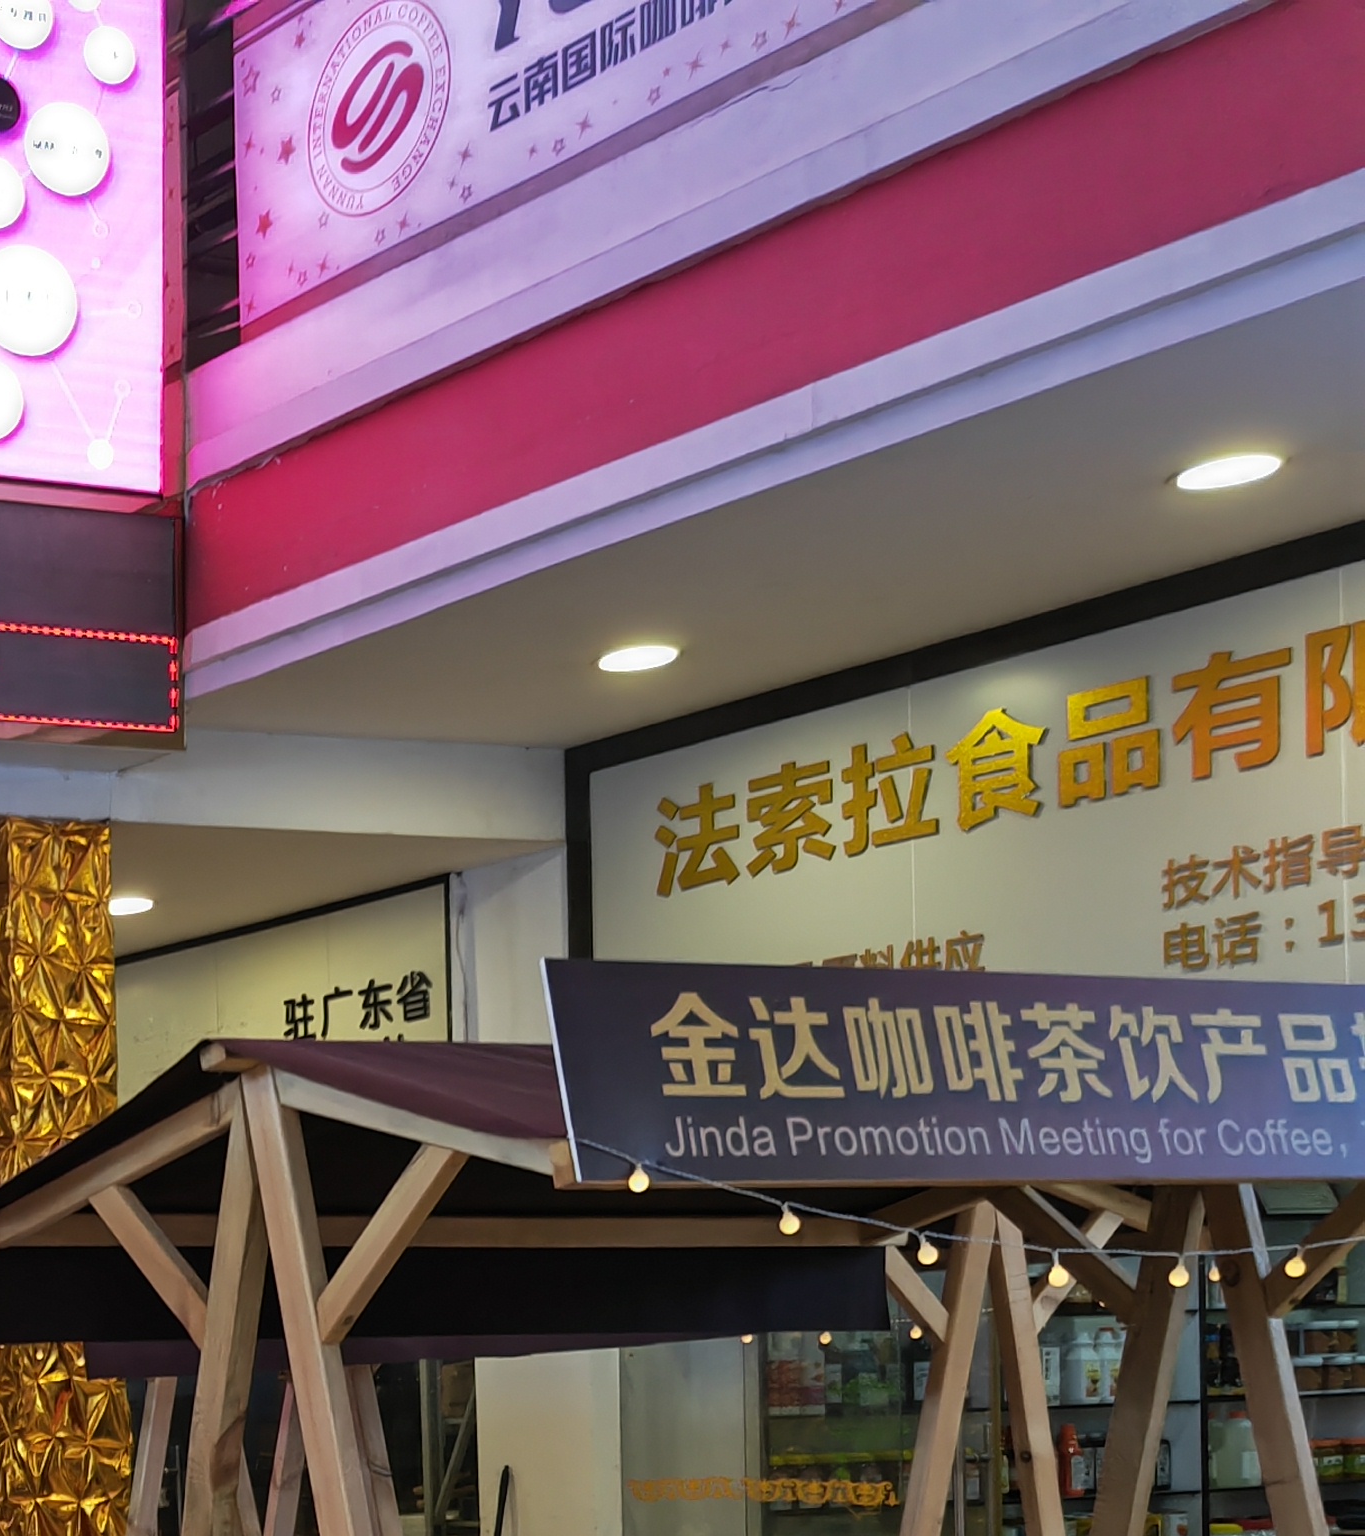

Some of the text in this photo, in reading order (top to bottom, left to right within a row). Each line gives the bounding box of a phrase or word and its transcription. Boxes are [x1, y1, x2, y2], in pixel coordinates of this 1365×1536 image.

[312, 6, 392, 158] INTERNATIONAL
[391, 66, 447, 193] EXCHANGE
[488, 0, 733, 132] 云南国际咖
[283, 970, 433, 1040] 驻广东省
[650, 991, 1365, 1104] 金达咖啡茶饮产品
[666, 1115, 1347, 1164] Jinda Promotion Meeting for Coffee,
